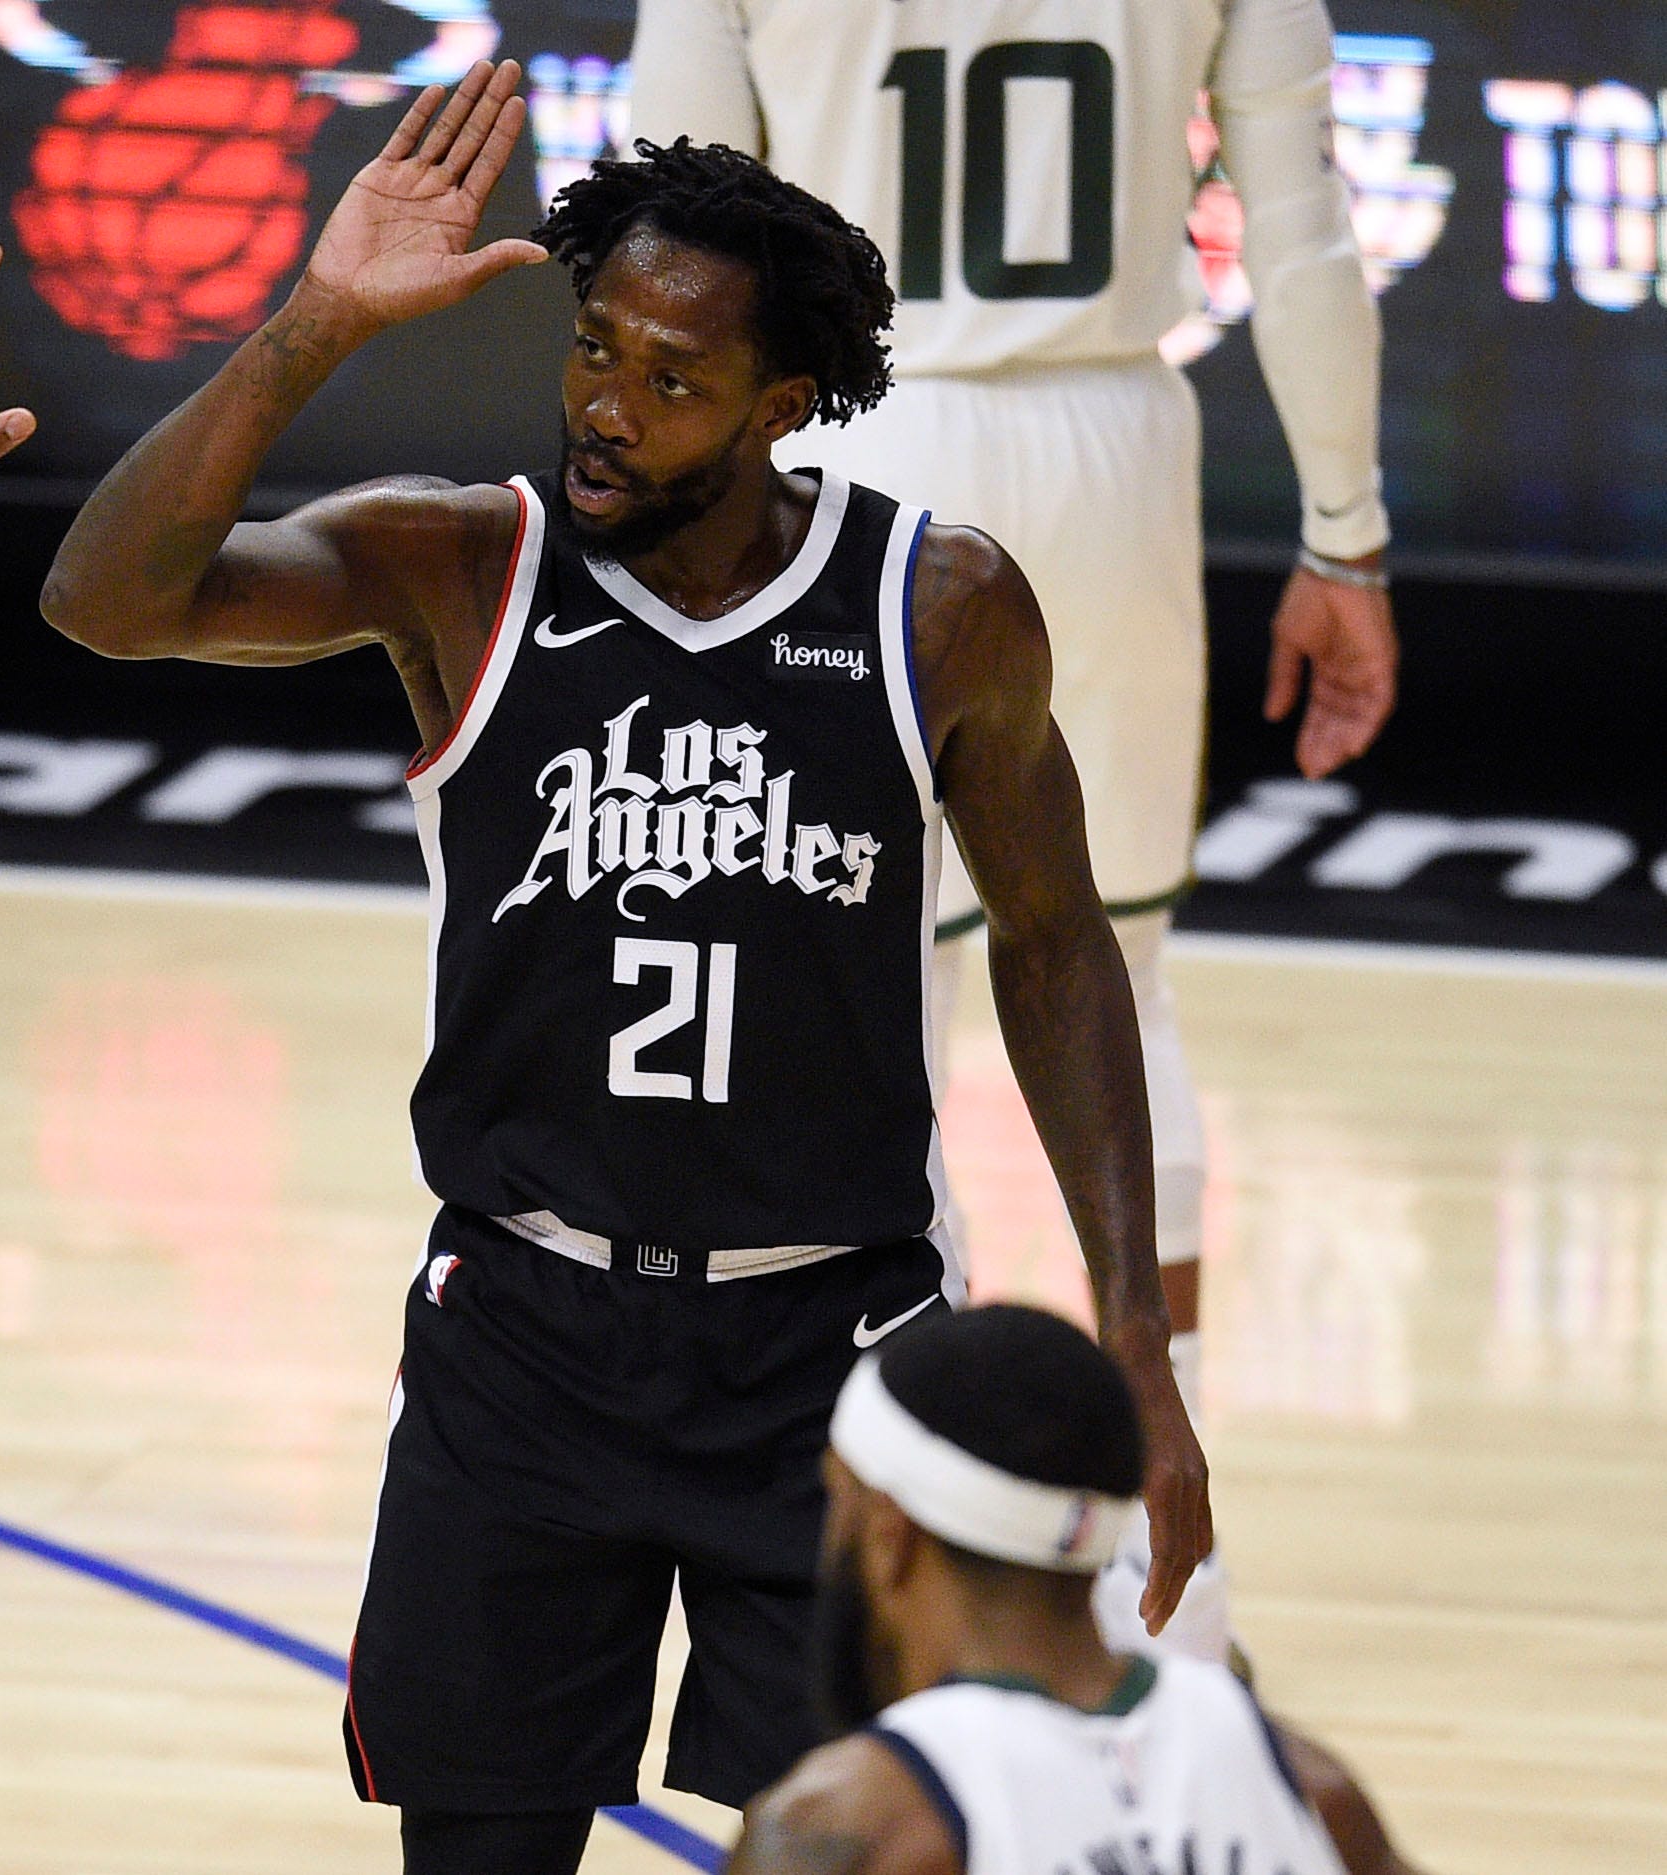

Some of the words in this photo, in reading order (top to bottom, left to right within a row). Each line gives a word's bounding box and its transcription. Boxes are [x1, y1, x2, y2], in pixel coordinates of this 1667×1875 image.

[877, 40, 1115, 300] 10
[1481, 79, 1667, 312] TO
[770, 633, 869, 681] honey
[492, 746, 881, 923] Angeles
[592, 695, 767, 804] Los
[608, 937, 737, 1104] 21
